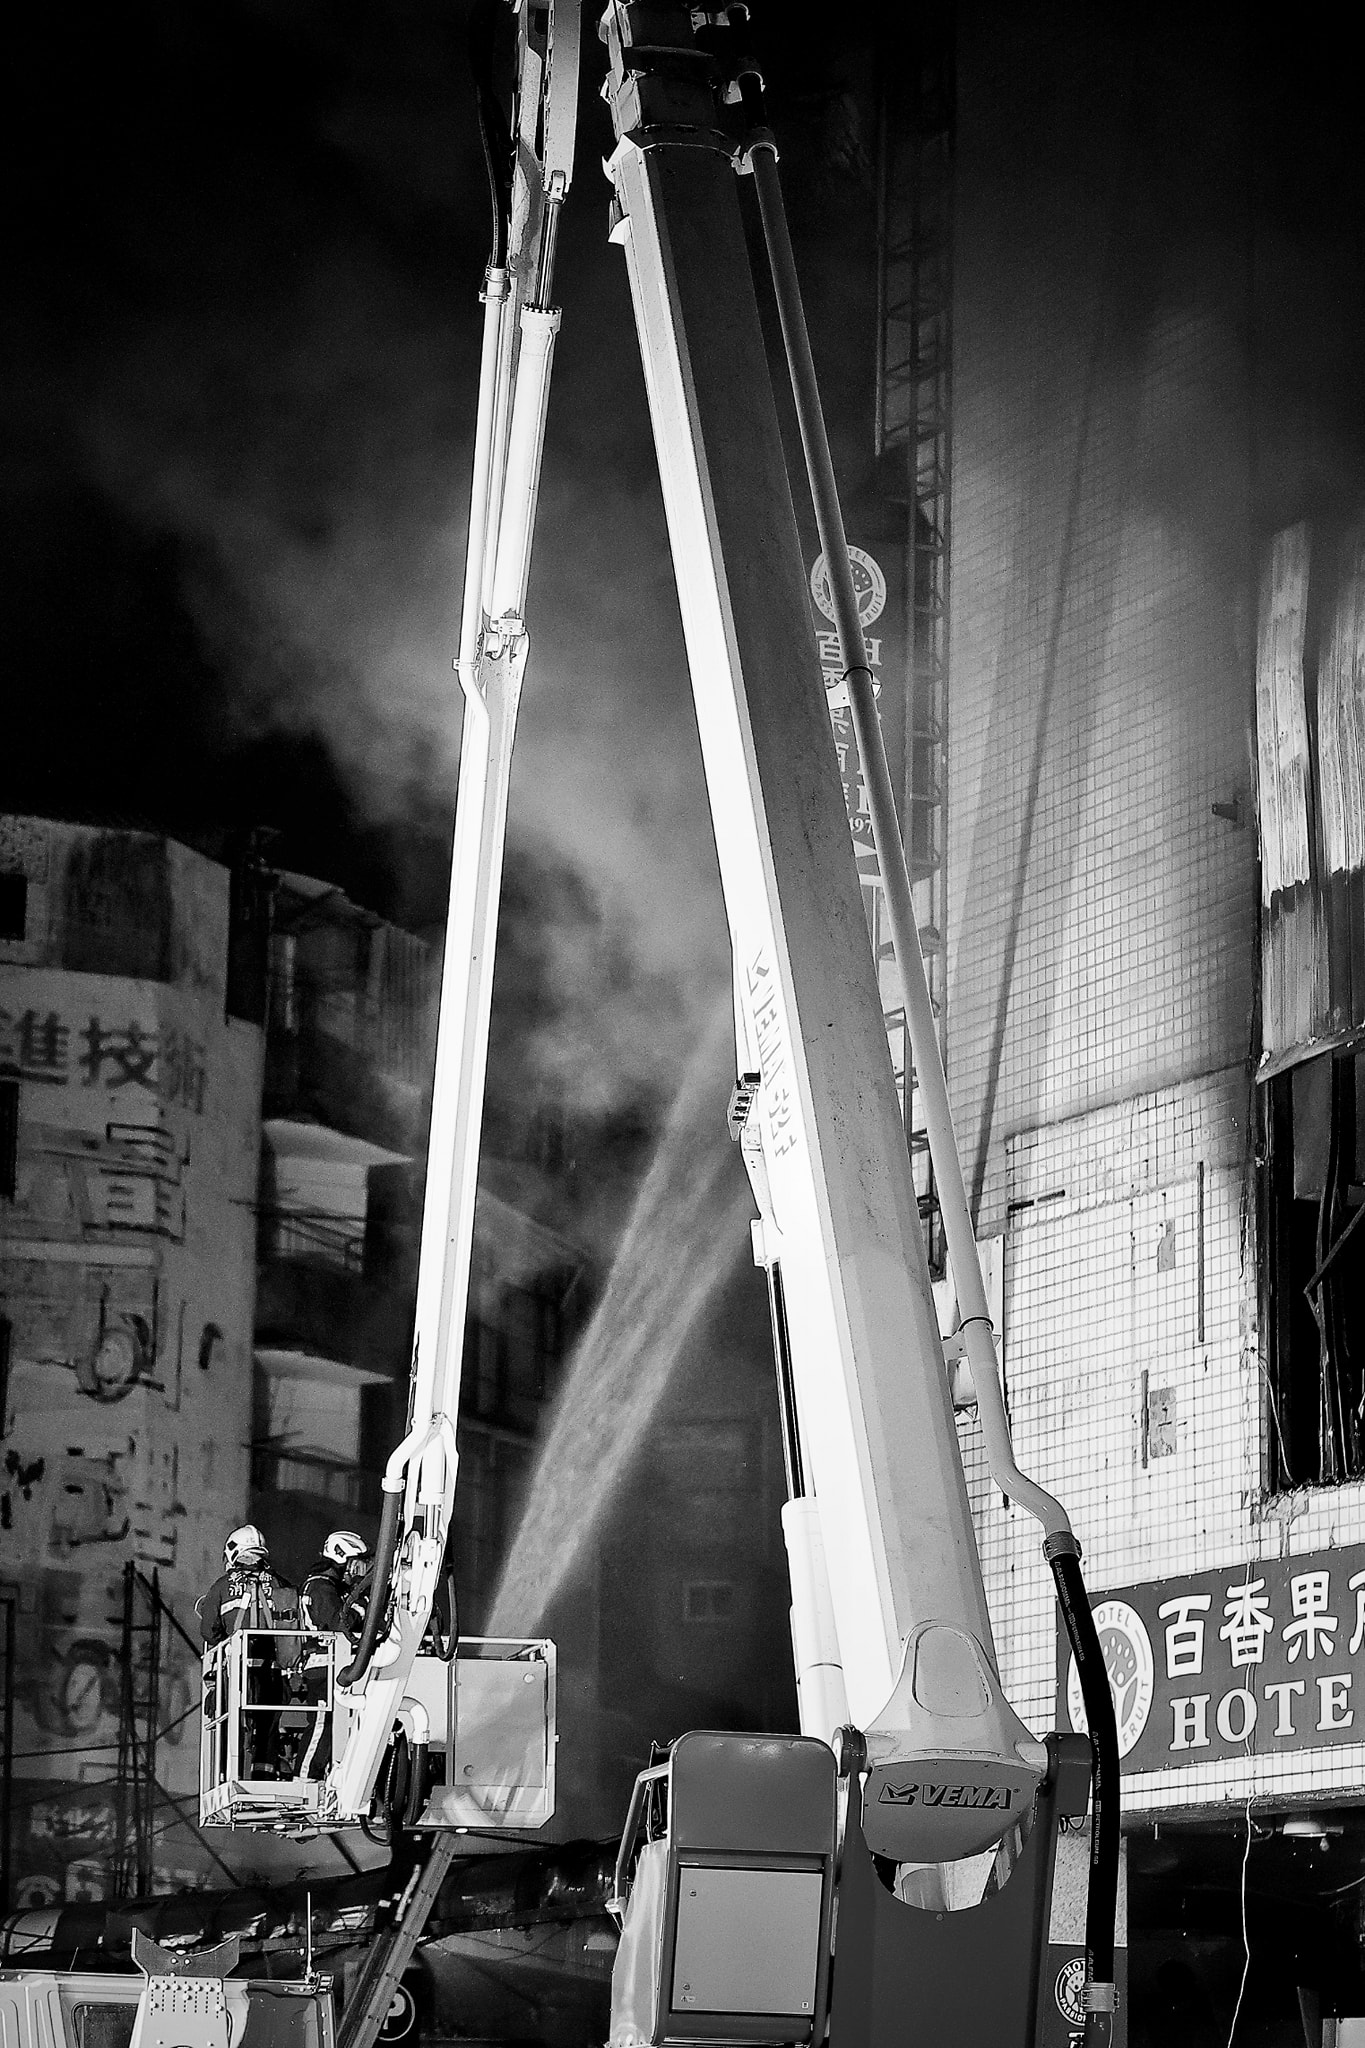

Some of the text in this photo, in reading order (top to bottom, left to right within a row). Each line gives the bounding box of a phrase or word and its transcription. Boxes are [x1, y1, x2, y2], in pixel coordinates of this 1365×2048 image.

[228, 1571, 272, 1582] 彰縣
[228, 1583, 273, 1597] 消局
[1122, 1680, 1149, 1747] FRUIT
[922, 1784, 1012, 1809] VEMA
